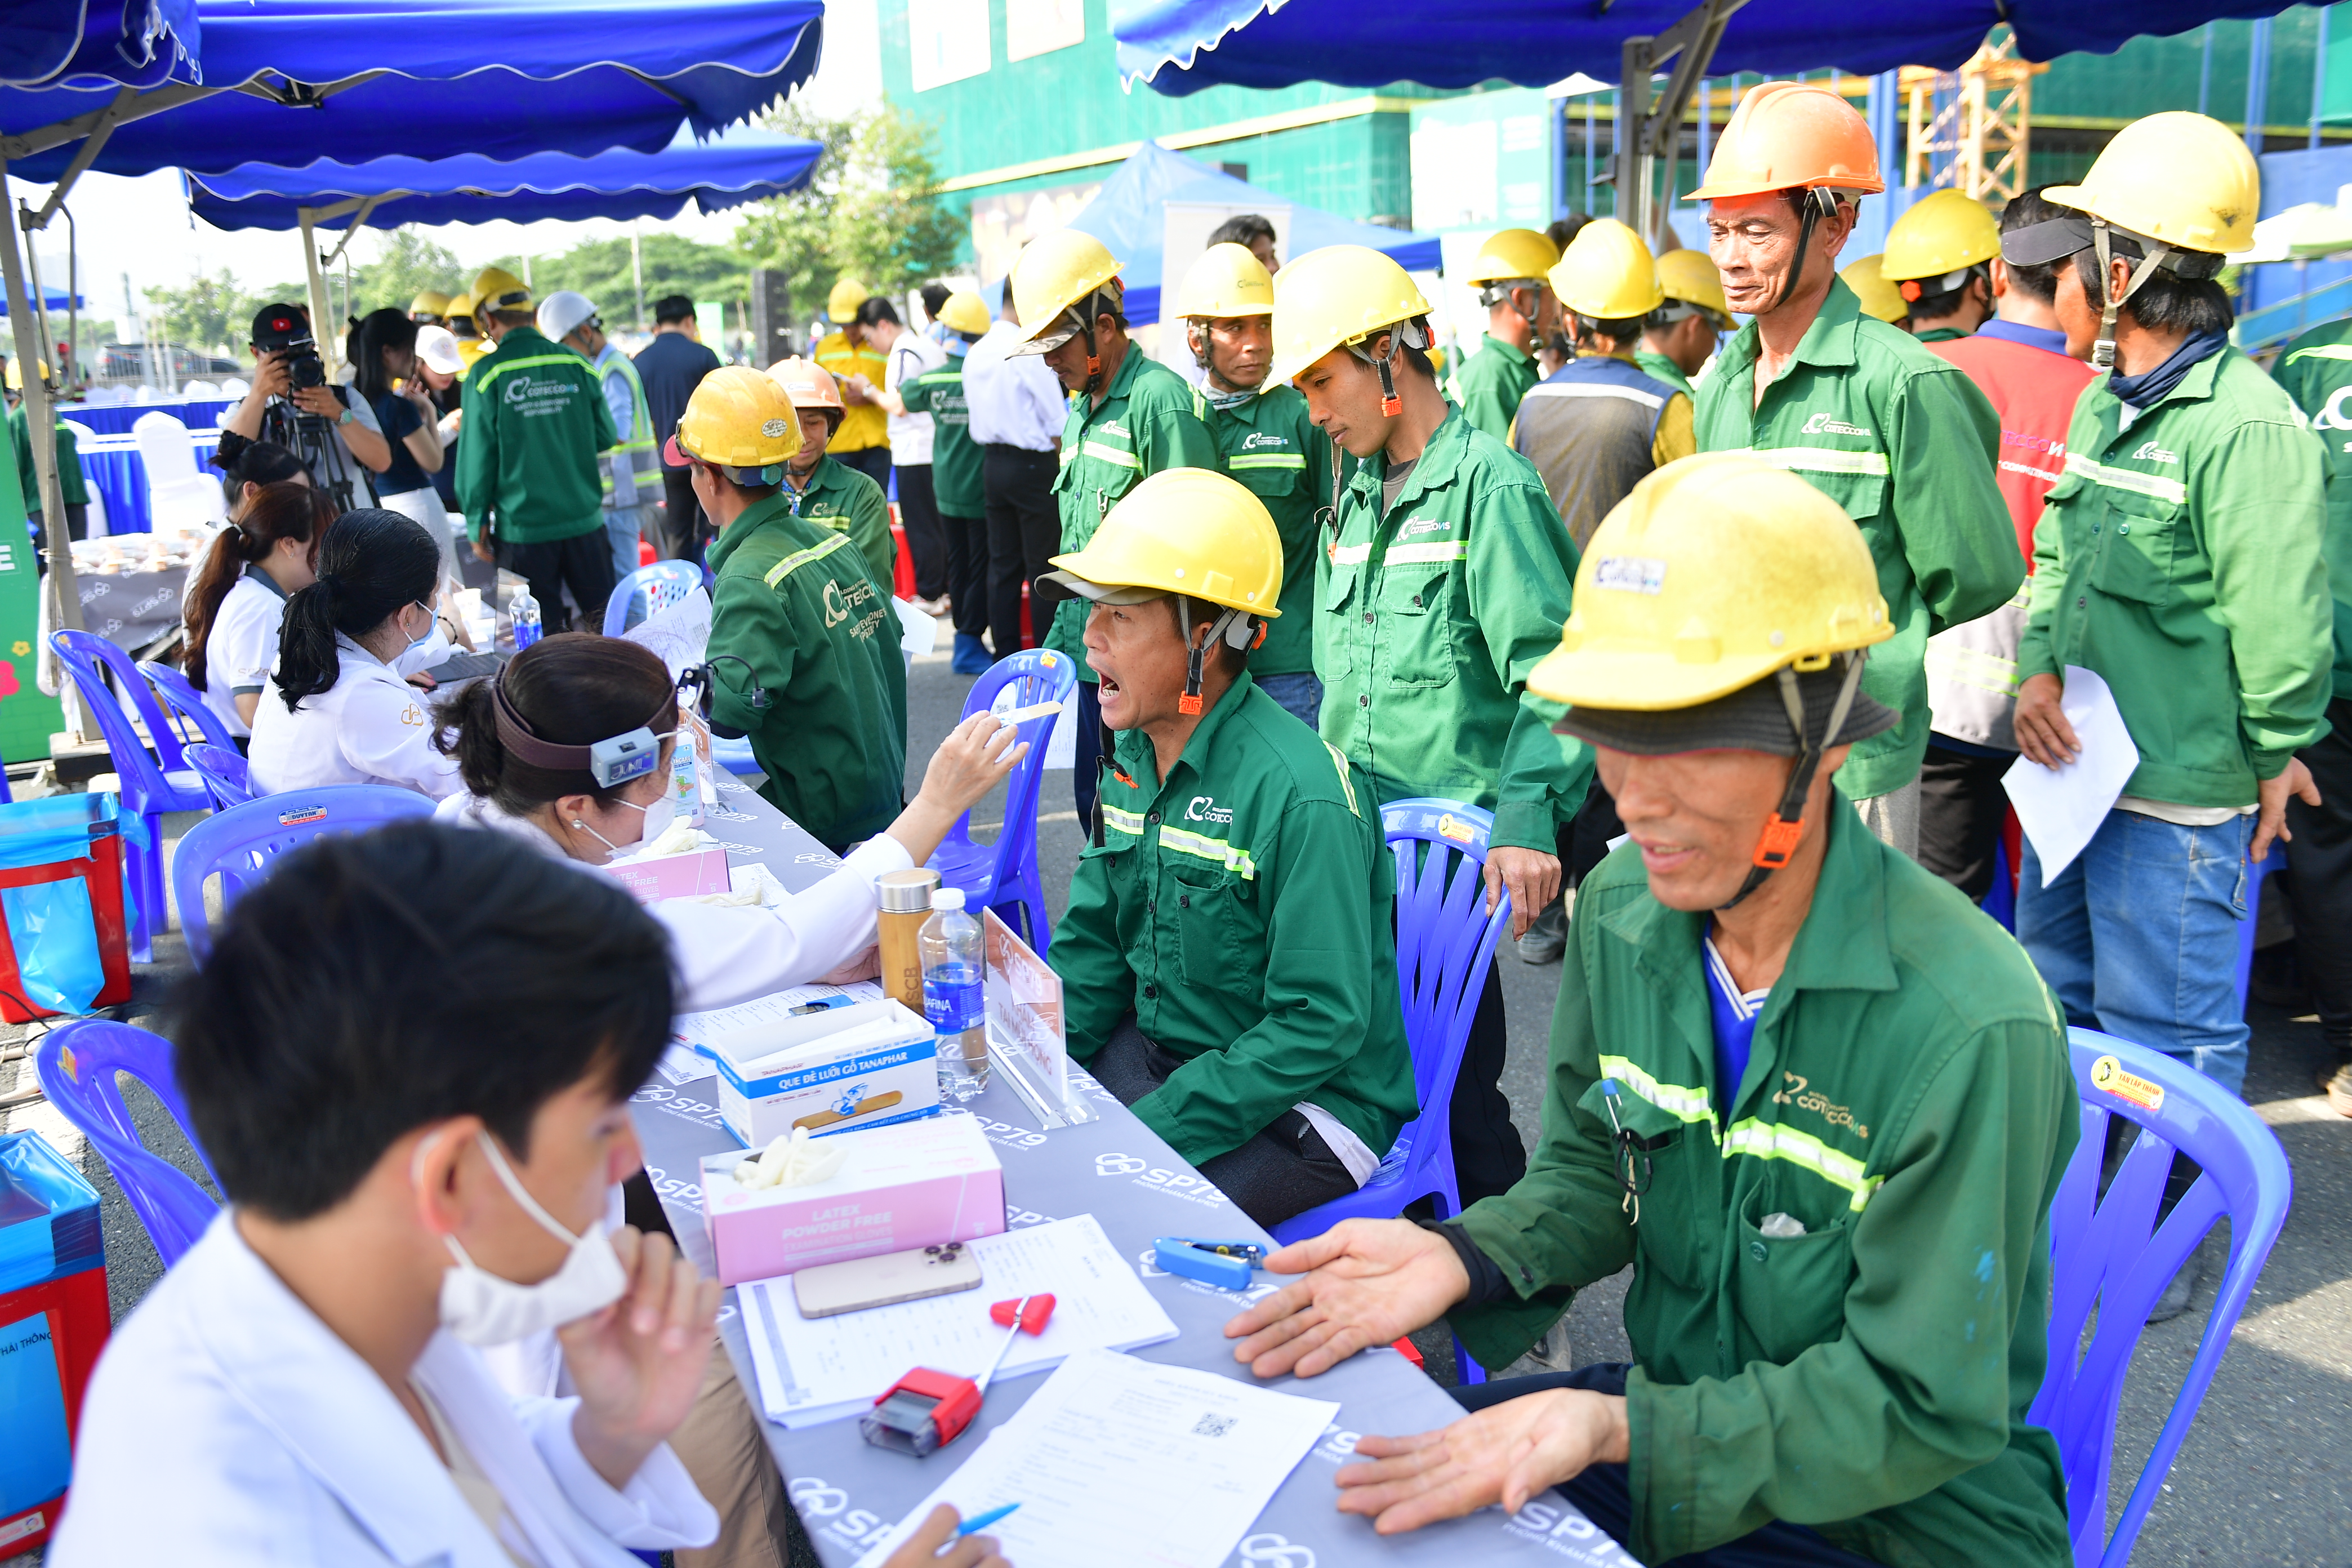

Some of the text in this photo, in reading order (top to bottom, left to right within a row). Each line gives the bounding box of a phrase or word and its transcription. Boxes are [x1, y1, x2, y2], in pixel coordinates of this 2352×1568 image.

[719, 841, 764, 854] SP79
[778, 1077, 800, 1089] QUE
[857, 1052, 908, 1067] TANAPHAR
[665, 1098, 723, 1125] SP7
[1141, 1168, 1229, 1202] SP79
[782, 1211, 893, 1240] POWDER FREE
[812, 1204, 861, 1222] LATEX
[783, 1226, 894, 1254] EXAMINATION GLOVES
[0, 1342, 19, 1356] HẢI
